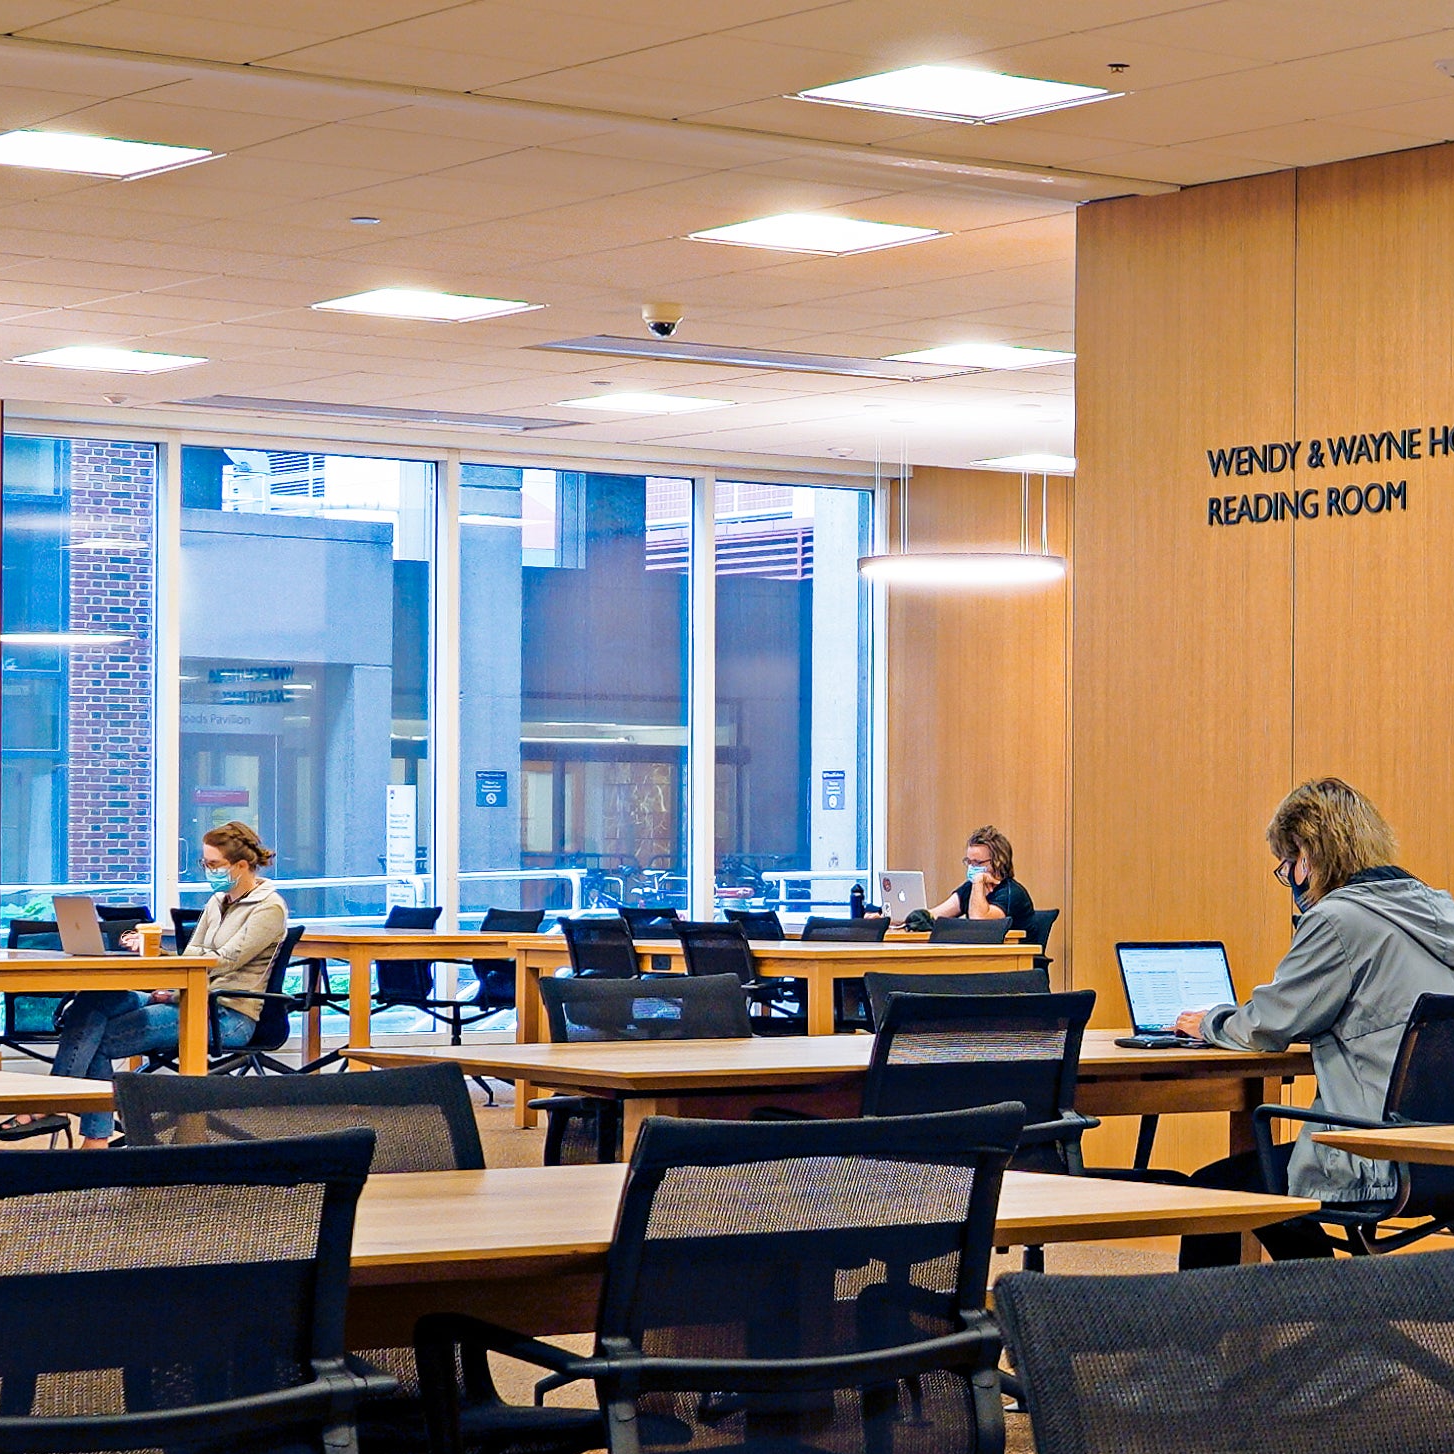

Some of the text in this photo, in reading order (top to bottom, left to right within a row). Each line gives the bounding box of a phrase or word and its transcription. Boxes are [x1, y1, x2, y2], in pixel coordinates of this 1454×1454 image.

[1207, 441, 1301, 477] WENDY
[1307, 440, 1325, 468] &
[1328, 428, 1421, 467] WAYNE
[1208, 480, 1407, 526] READING ROOM
